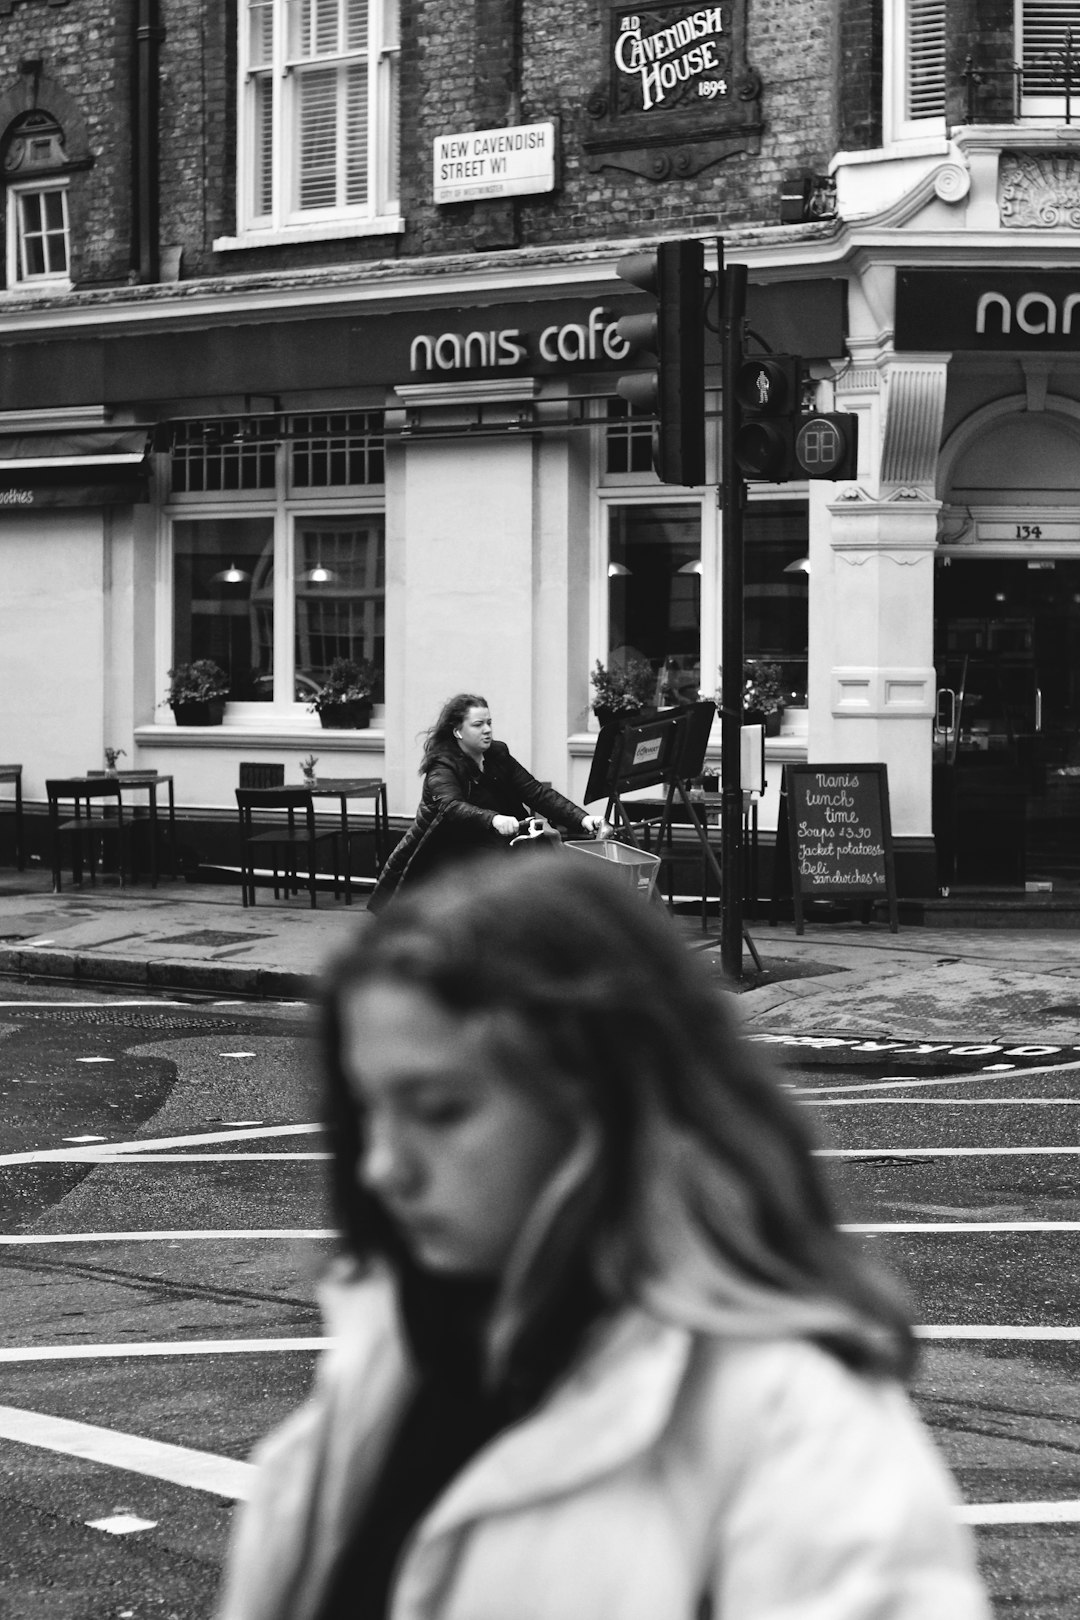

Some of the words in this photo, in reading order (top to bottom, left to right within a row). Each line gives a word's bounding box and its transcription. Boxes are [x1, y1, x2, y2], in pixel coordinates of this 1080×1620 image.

[620, 16, 640, 31] AD
[615, 7, 722, 74] CAVENDISH
[641, 41, 719, 110] HOUSE
[698, 80, 727, 99] 1894
[441, 141, 469, 160] NEW
[473, 132, 545, 156] CAVENDISH
[441, 160, 485, 180] STREET
[490, 157, 507, 174] W1
[410, 329, 520, 371] nanis
[539, 306, 631, 362] cafe
[1016, 525, 1042, 540] 134
[824, 806, 859, 824] time
[798, 842, 835, 860] Jacket
[800, 859, 830, 875] Deli
[812, 868, 873, 885] sandwiches
